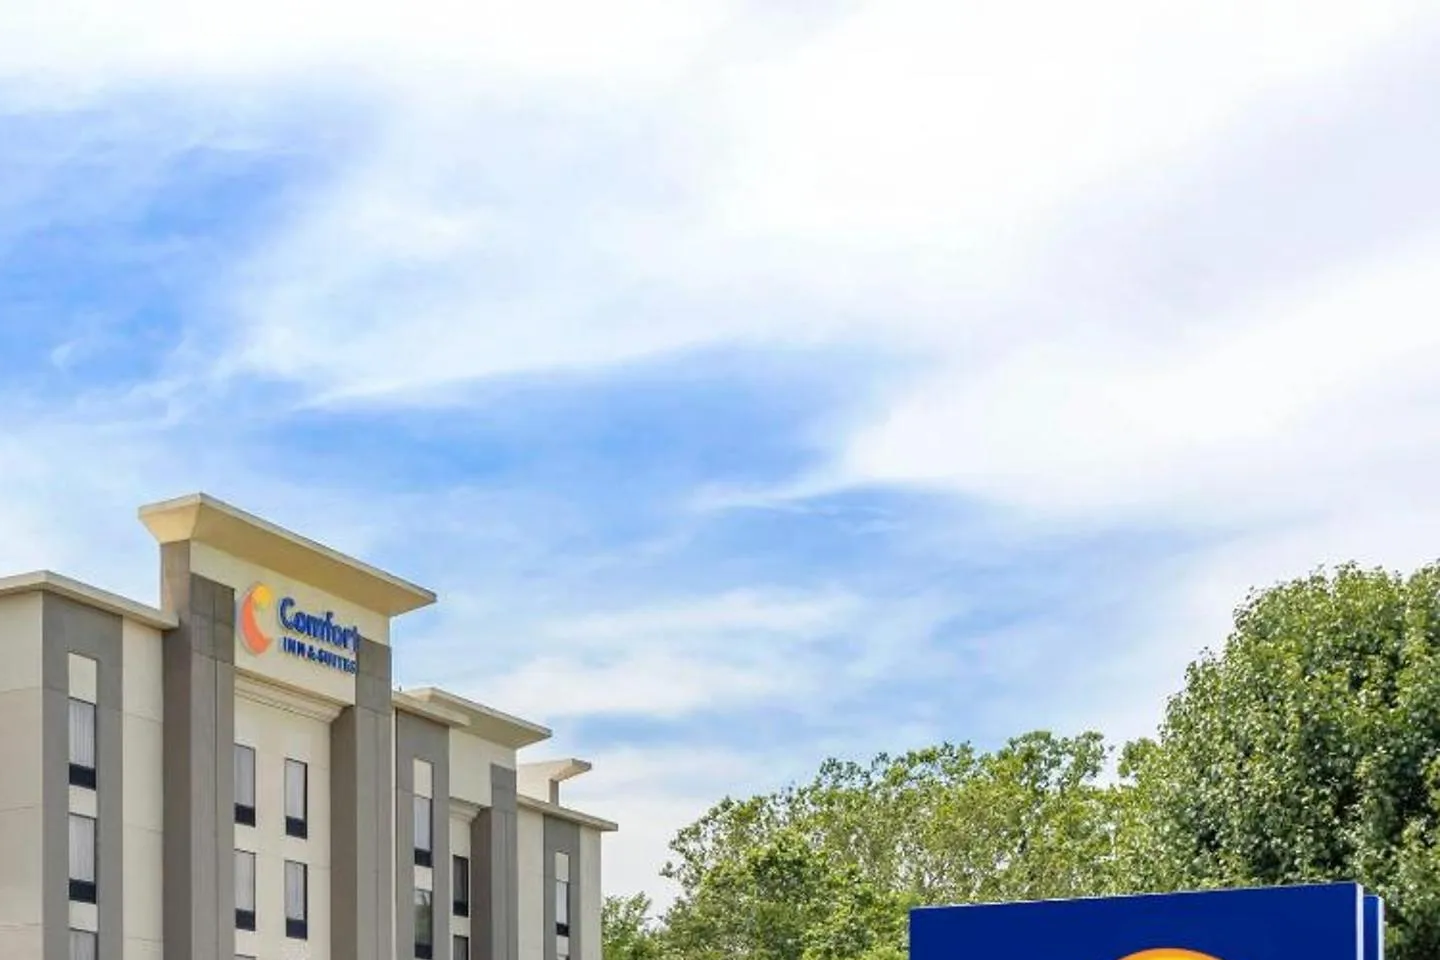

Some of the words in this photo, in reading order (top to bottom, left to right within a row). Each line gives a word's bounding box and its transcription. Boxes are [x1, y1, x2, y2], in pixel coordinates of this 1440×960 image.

[280, 597, 359, 653] Comfort
[283, 636, 306, 658] INN
[307, 645, 317, 662] &
[318, 649, 357, 675] SUITES
